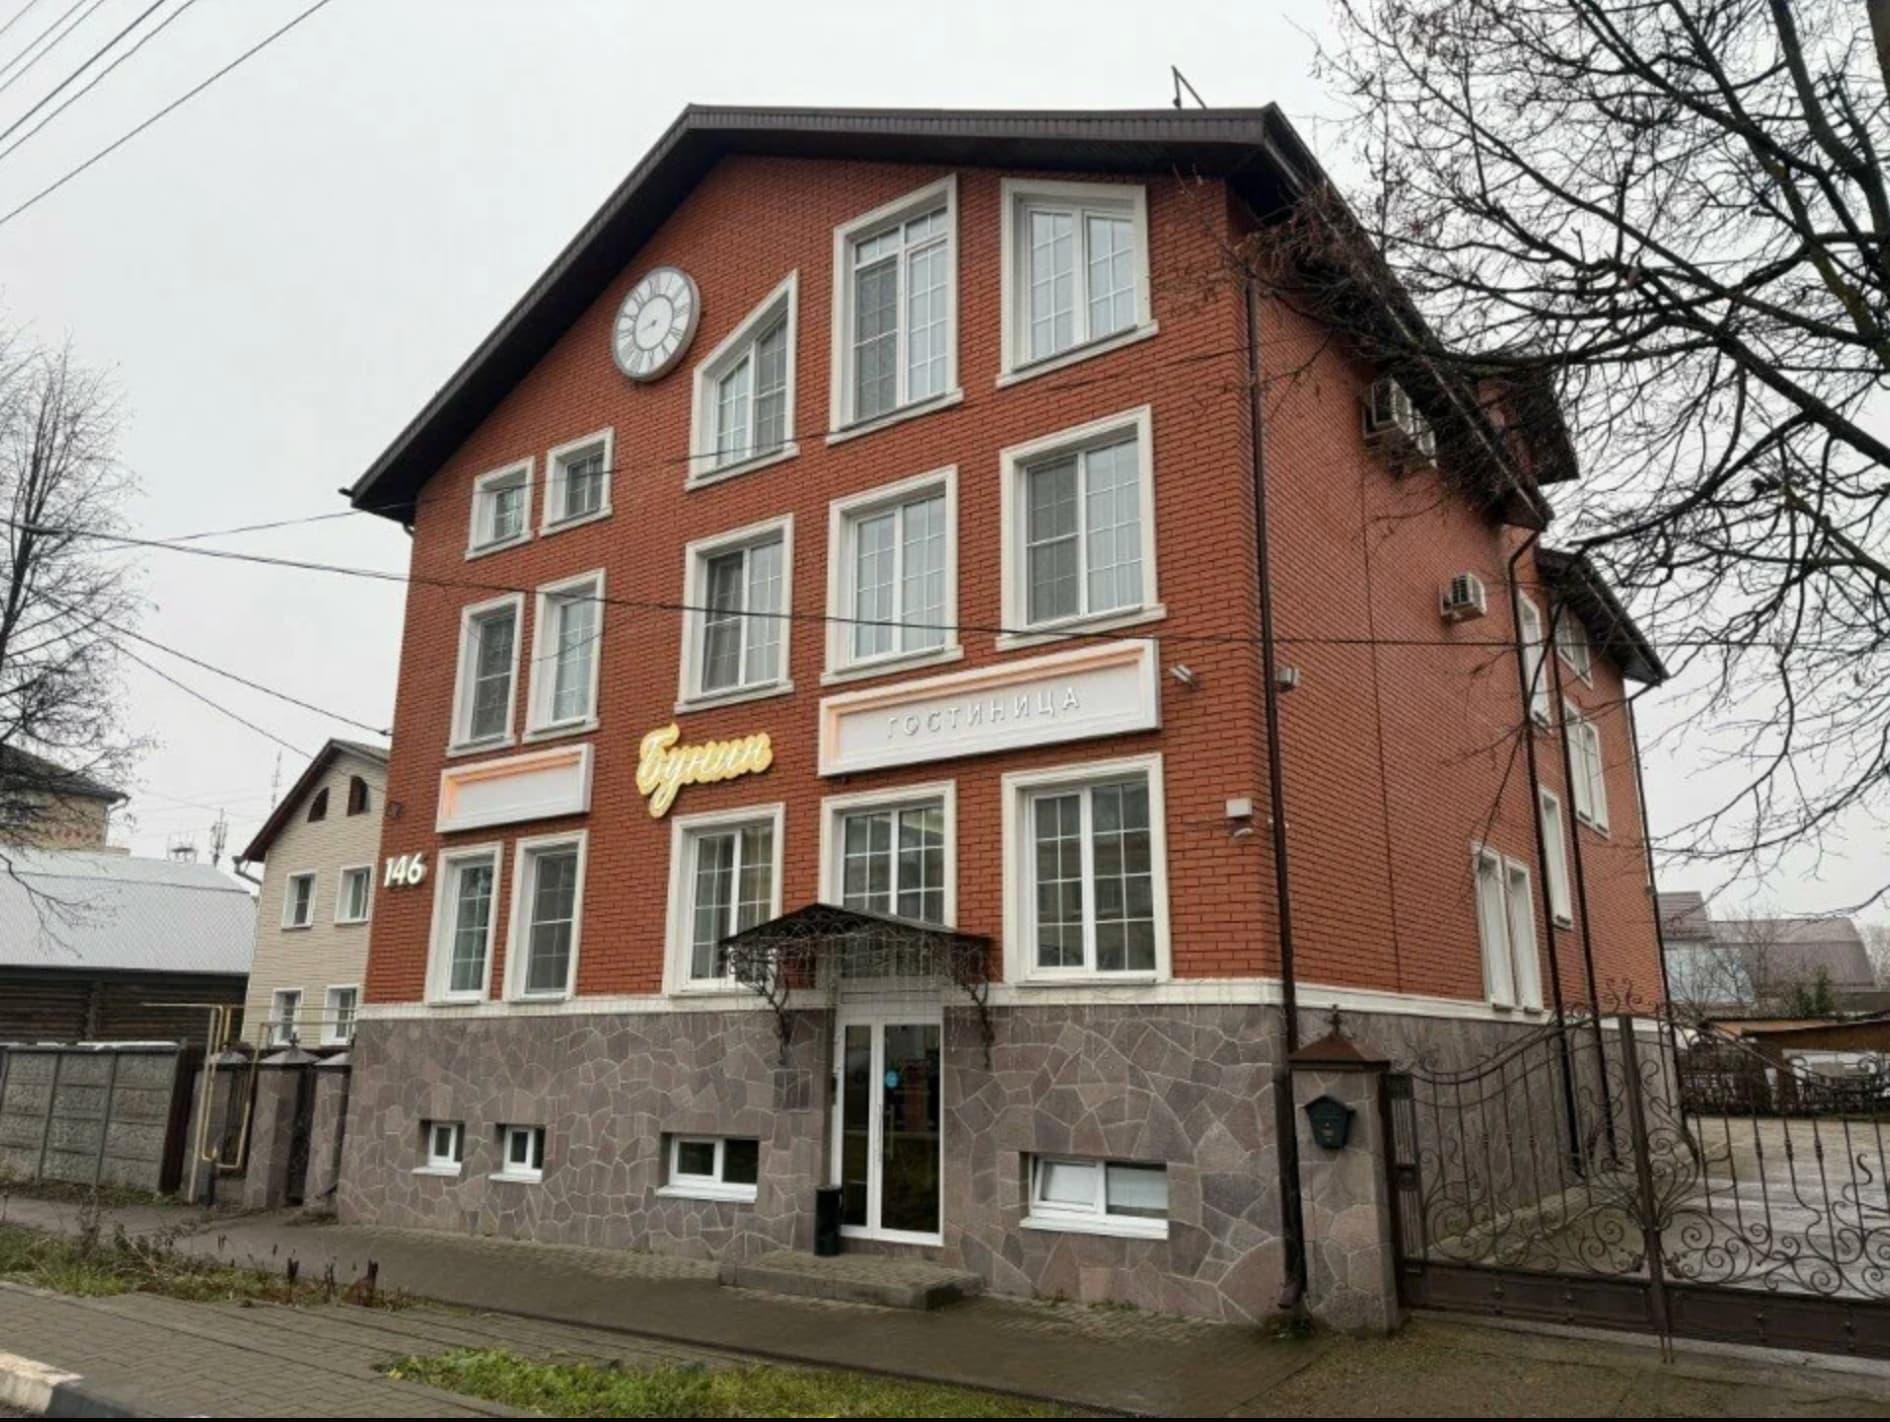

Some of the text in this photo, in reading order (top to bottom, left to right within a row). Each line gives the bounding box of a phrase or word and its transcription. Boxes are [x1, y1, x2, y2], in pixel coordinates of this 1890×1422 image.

[887, 687, 1081, 739] ГОСТИНИЦА
[636, 722, 773, 819] Бунин
[383, 851, 427, 888] 146
